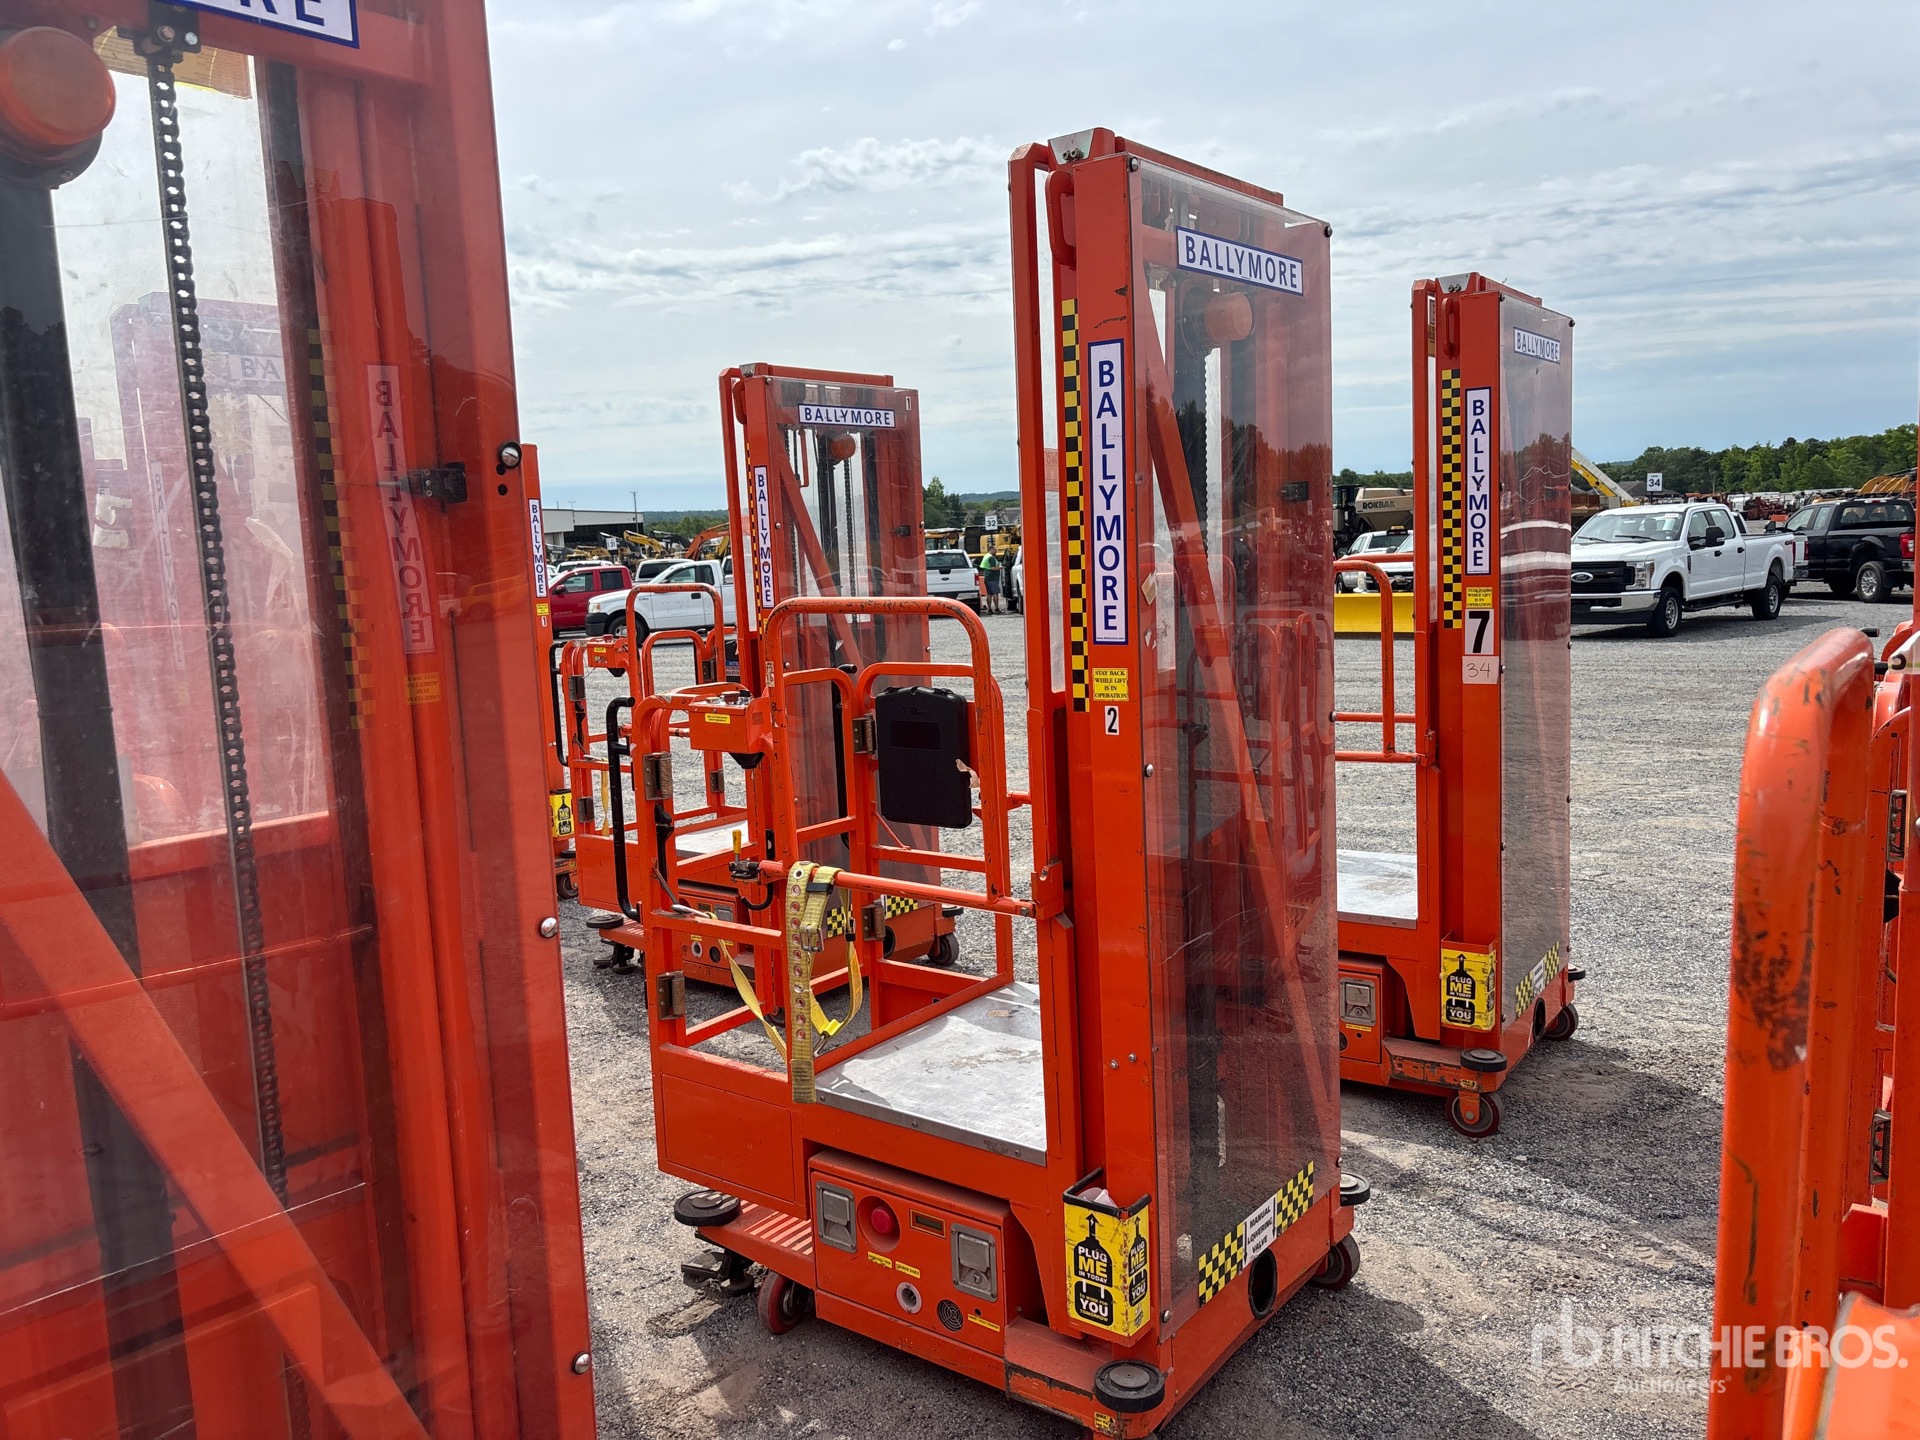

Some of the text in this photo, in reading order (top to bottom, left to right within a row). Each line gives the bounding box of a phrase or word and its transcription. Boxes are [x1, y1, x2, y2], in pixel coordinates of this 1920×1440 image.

[1185, 235, 1297, 288] BALLYMORE
[1517, 332, 1559, 360] BALLYMORE
[804, 407, 891, 425] BALLYMORE
[1469, 399, 1488, 567] BALLYMORE
[1649, 478, 1660, 487] 34
[1096, 359, 1122, 631] BALLYMORE
[1362, 501, 1396, 509] ROKBAK
[986, 519, 996, 527] 32
[758, 474, 771, 602] BALLYMORE
[531, 504, 545, 594] BALLYMORE
[1469, 611, 1490, 653] 7
[1466, 662, 1491, 678] 34
[1107, 707, 1118, 733] 2
[1450, 975, 1472, 984] PLUG
[1450, 981, 1472, 994] ME
[1449, 1009, 1471, 1019] YOU
[1250, 1206, 1270, 1229] MANUAL
[1247, 1217, 1272, 1245] LOWERING
[1131, 1240, 1145, 1256] PLUG
[1252, 1235, 1268, 1253] VALVE
[1078, 1246, 1107, 1262] PLUG
[1131, 1249, 1145, 1268] ME
[1079, 1256, 1107, 1278] ME
[1087, 1272, 1107, 1284] TODAY
[1131, 1283, 1145, 1299] YOU
[1079, 1309, 1108, 1322] TOMORROW
[1080, 1298, 1108, 1317] YOU
